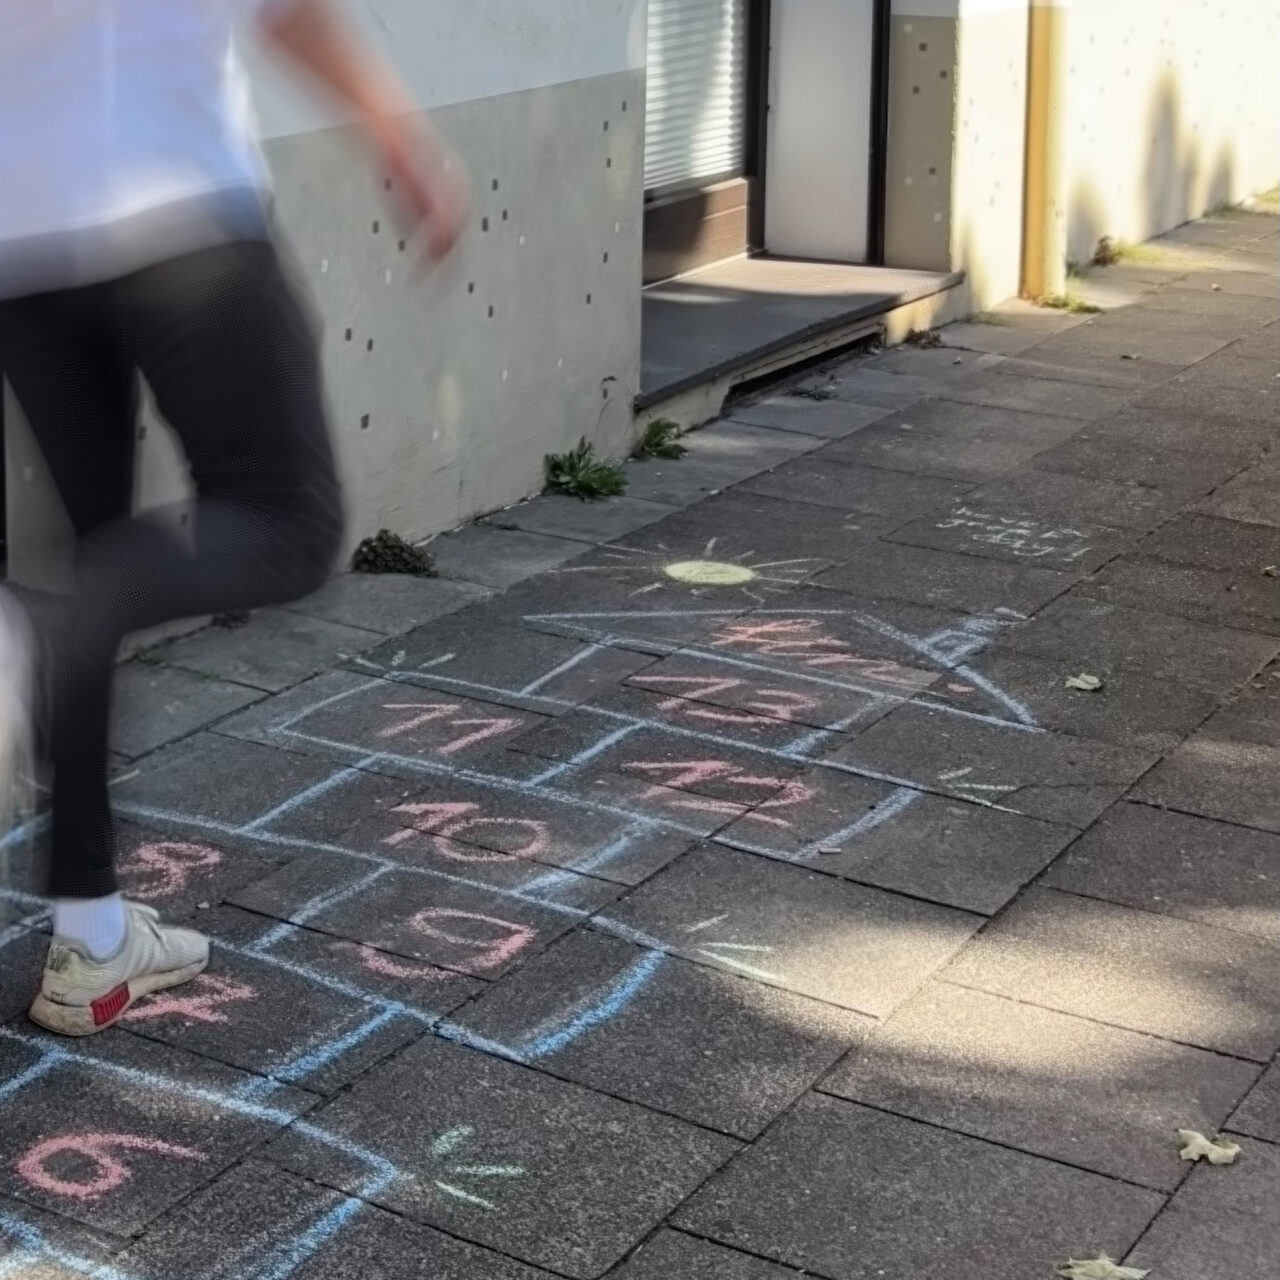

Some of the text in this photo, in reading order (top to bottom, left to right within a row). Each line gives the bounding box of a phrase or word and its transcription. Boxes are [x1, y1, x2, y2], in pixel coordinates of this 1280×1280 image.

[375, 702, 526, 755] 11
[626, 673, 818, 724] 13
[621, 758, 816, 828] 12
[379, 801, 551, 863] 10
[358, 906, 538, 982] 9
[15, 1132, 210, 1200] 6
